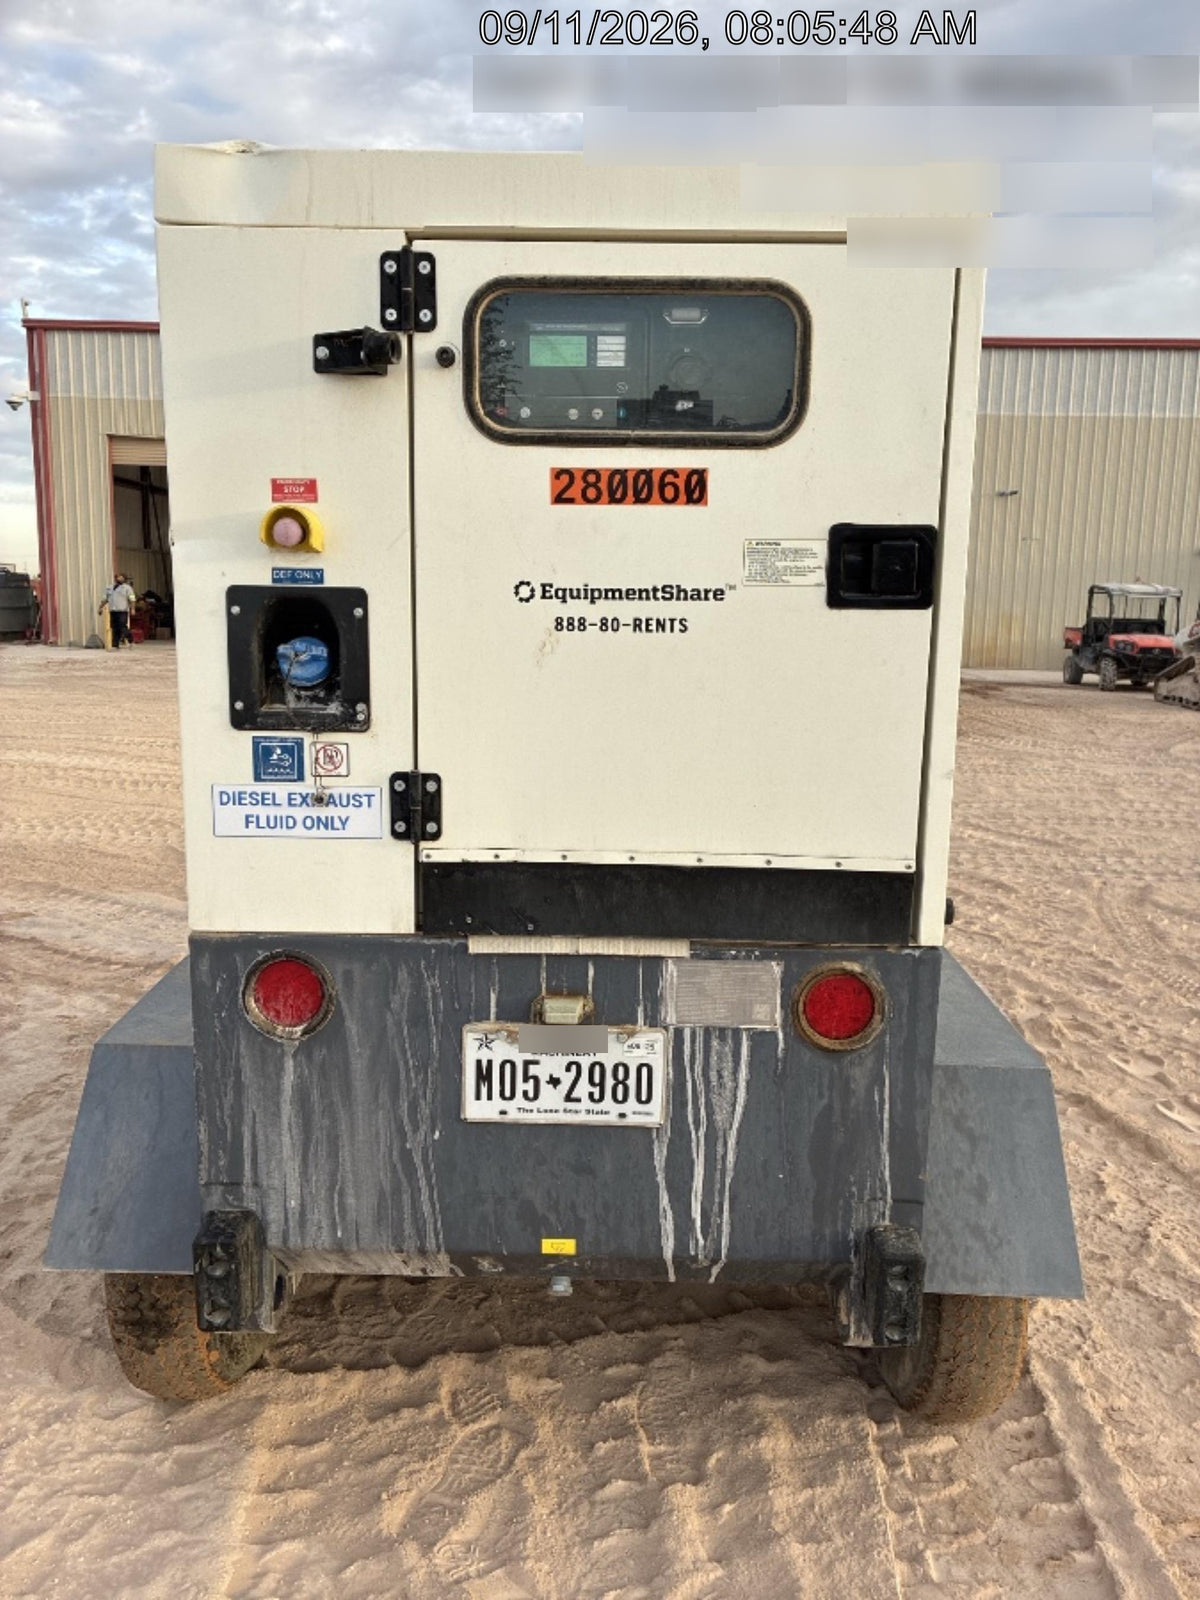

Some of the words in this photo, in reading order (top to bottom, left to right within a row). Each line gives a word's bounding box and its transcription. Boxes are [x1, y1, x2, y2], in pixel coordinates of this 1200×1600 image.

[283, 485, 305, 493] STOP
[553, 468, 707, 504] 280060
[273, 569, 292, 579] DEF
[294, 569, 322, 580] ONLY
[554, 616, 689, 633] 888-80-RENTS
[218, 790, 281, 807] DIESEL
[287, 792, 375, 808] EXAUST
[244, 814, 298, 830] FLUID
[302, 815, 350, 831] ONLY
[474, 1059, 541, 1102] M05
[563, 1060, 654, 1105] 2980
